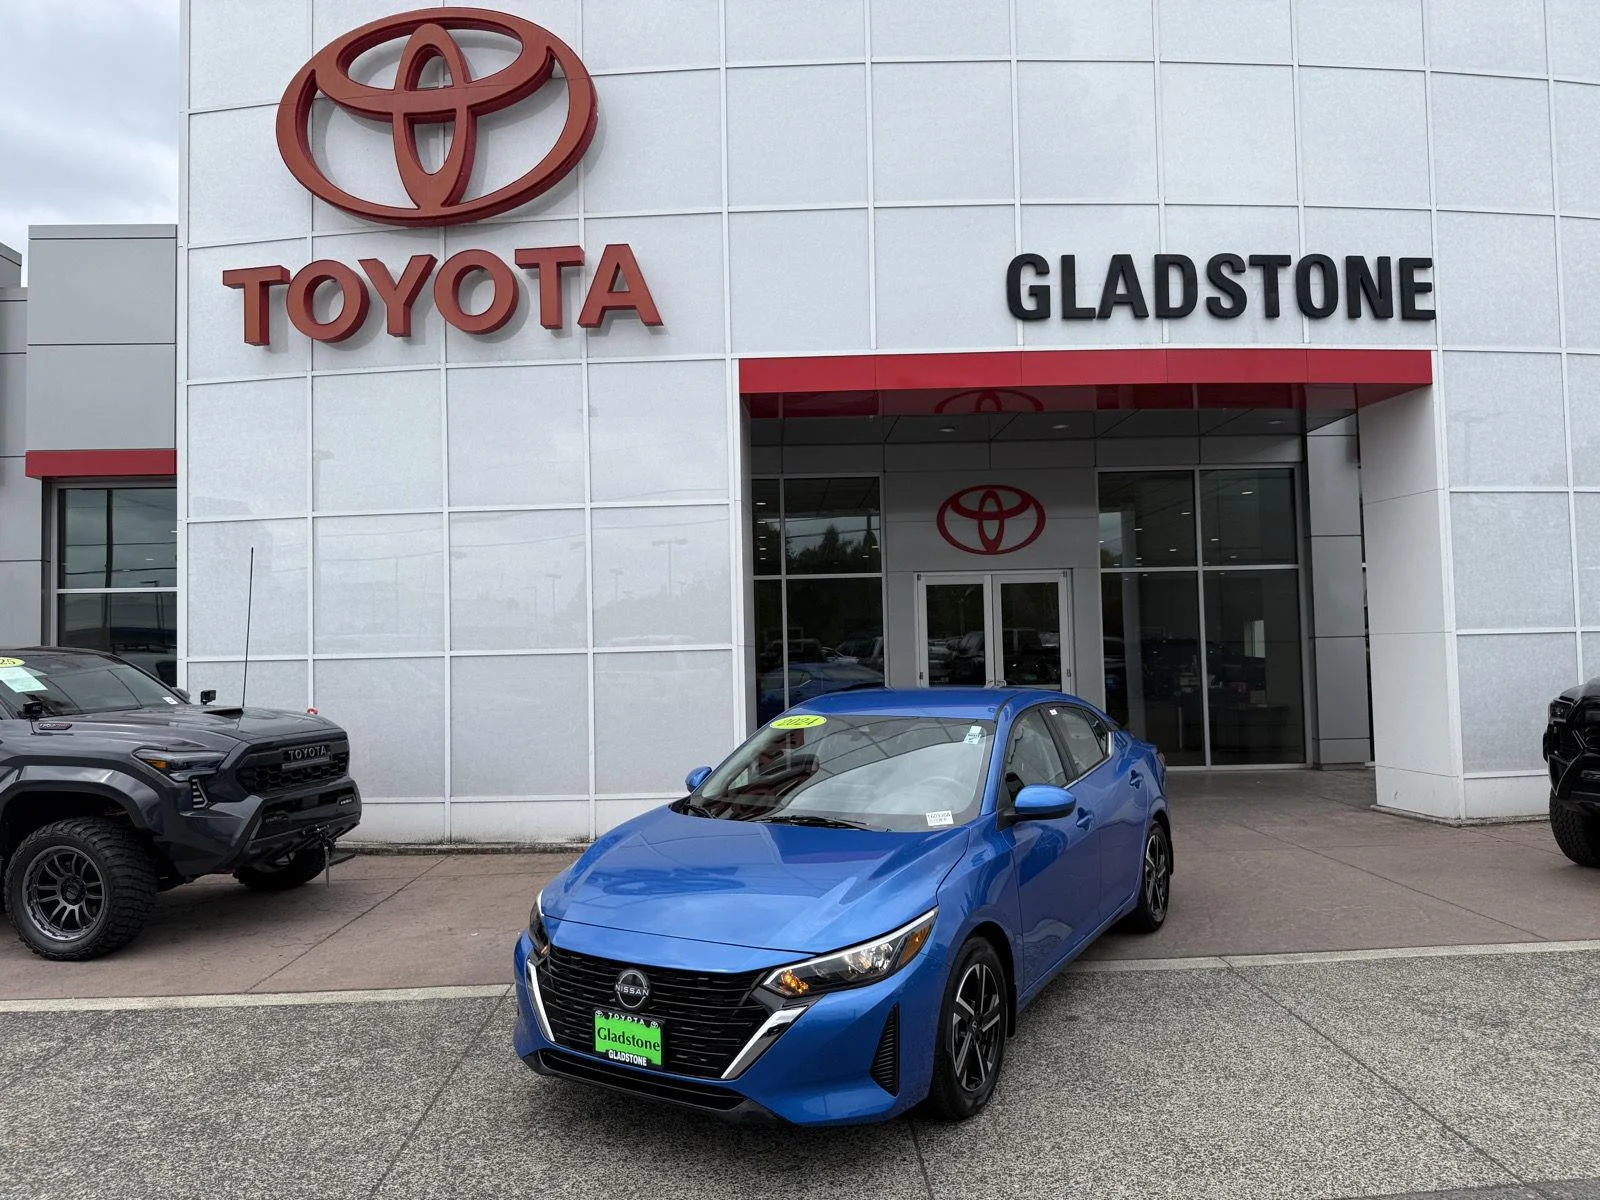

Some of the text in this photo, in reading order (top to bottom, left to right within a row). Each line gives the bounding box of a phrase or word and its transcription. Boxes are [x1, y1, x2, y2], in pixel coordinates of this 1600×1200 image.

[222, 243, 664, 346] TOYOTA
[1006, 253, 1436, 321] GLADSTONE
[777, 718, 819, 726] 2024
[288, 745, 327, 760] TOYOTA
[615, 984, 649, 996] NISSAN
[608, 1012, 645, 1025] TOYOTA
[597, 1027, 661, 1052] Gladstone
[608, 1050, 647, 1066] GLADSTONE
